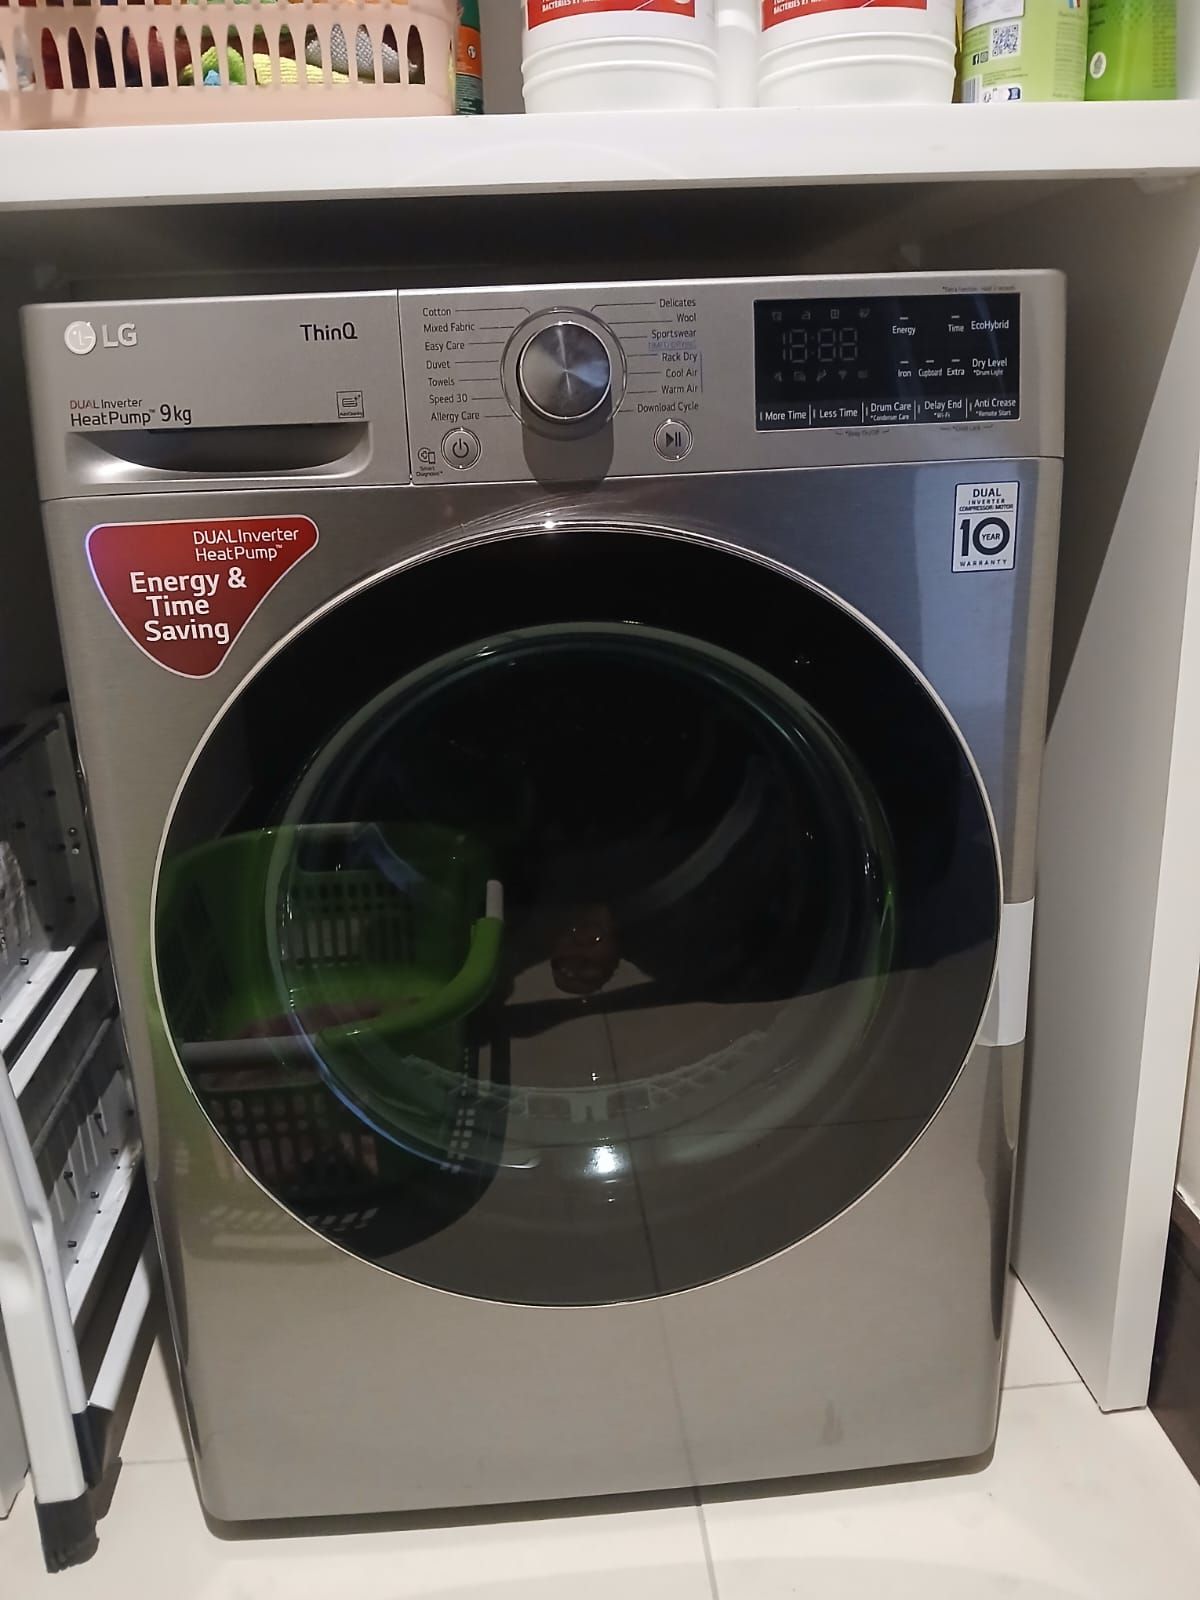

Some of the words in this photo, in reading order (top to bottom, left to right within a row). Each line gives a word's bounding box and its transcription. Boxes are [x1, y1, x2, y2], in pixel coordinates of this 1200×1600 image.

[660, 298, 696, 308] Delicates
[423, 307, 451, 317] Cotton
[676, 312, 696, 322] Wool
[300, 321, 358, 342] ThinQ
[424, 323, 448, 332] Mixed
[450, 322, 475, 332] Fabric
[892, 325, 916, 335] Energy
[948, 323, 964, 332] Time
[971, 320, 1009, 331] EcoHybrid
[101, 323, 138, 348] LG
[652, 328, 696, 340] Sportswear
[425, 342, 444, 352] Easy
[447, 341, 465, 350] Care
[662, 352, 679, 362] Rack
[682, 352, 697, 362] Dry
[426, 360, 450, 370] Duvet
[972, 358, 985, 369] Dry
[987, 357, 1007, 367] Level
[666, 368, 683, 378] Cool
[686, 368, 697, 377] Air
[898, 369, 911, 378] Iron
[918, 368, 942, 378] Cupboard
[947, 367, 965, 376] Extra
[428, 377, 454, 387] Towels
[661, 385, 685, 394] Warm
[687, 384, 698, 394] Air
[70, 399, 100, 410] DUAL
[101, 397, 142, 408] Inverter
[429, 394, 454, 404] Speed
[456, 394, 468, 403] 30
[974, 398, 990, 408] Anti
[991, 397, 1016, 407] Crease
[637, 402, 676, 412] Download
[678, 401, 699, 412] Cycle
[871, 402, 892, 412] Drum
[894, 401, 911, 411] Care
[924, 400, 945, 411] Delay
[948, 399, 962, 409] End
[431, 411, 458, 422] Allergy
[462, 411, 480, 420] Care
[765, 410, 786, 421] More
[786, 410, 807, 420] Time
[819, 409, 838, 418] Less
[840, 408, 858, 417] Time
[973, 488, 1001, 497] DUAL
[960, 517, 1010, 556] 10
[982, 533, 1000, 541] YEAR
[129, 571, 220, 596] Energy
[228, 567, 247, 589] &
[146, 595, 210, 617] Time
[144, 619, 230, 645] Saving
